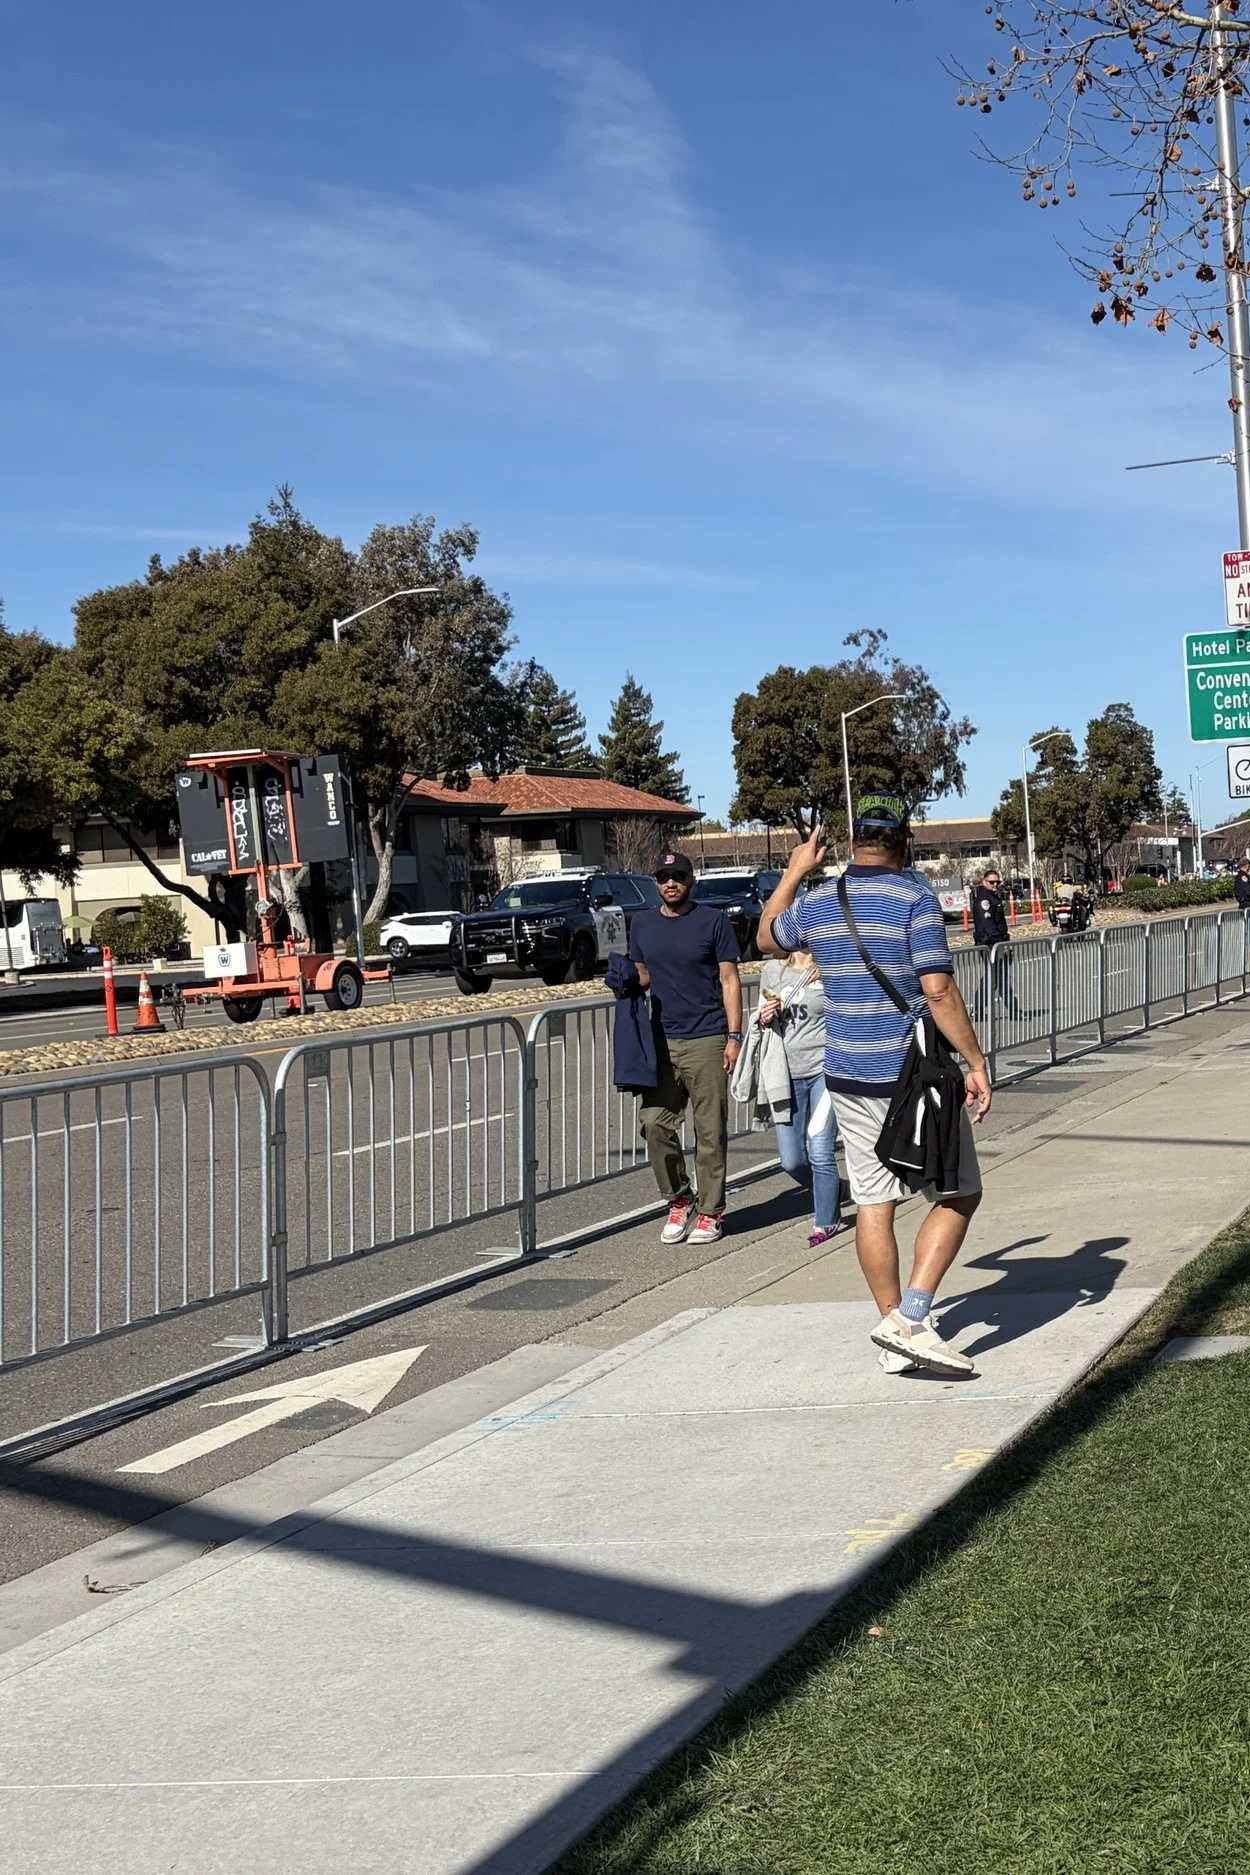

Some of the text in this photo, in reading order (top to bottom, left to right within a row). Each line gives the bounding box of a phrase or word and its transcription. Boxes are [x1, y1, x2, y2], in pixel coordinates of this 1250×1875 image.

[1225, 564, 1239, 577] NO
[1192, 640, 1231, 657] Hotel
[323, 772, 338, 820] WANCO
